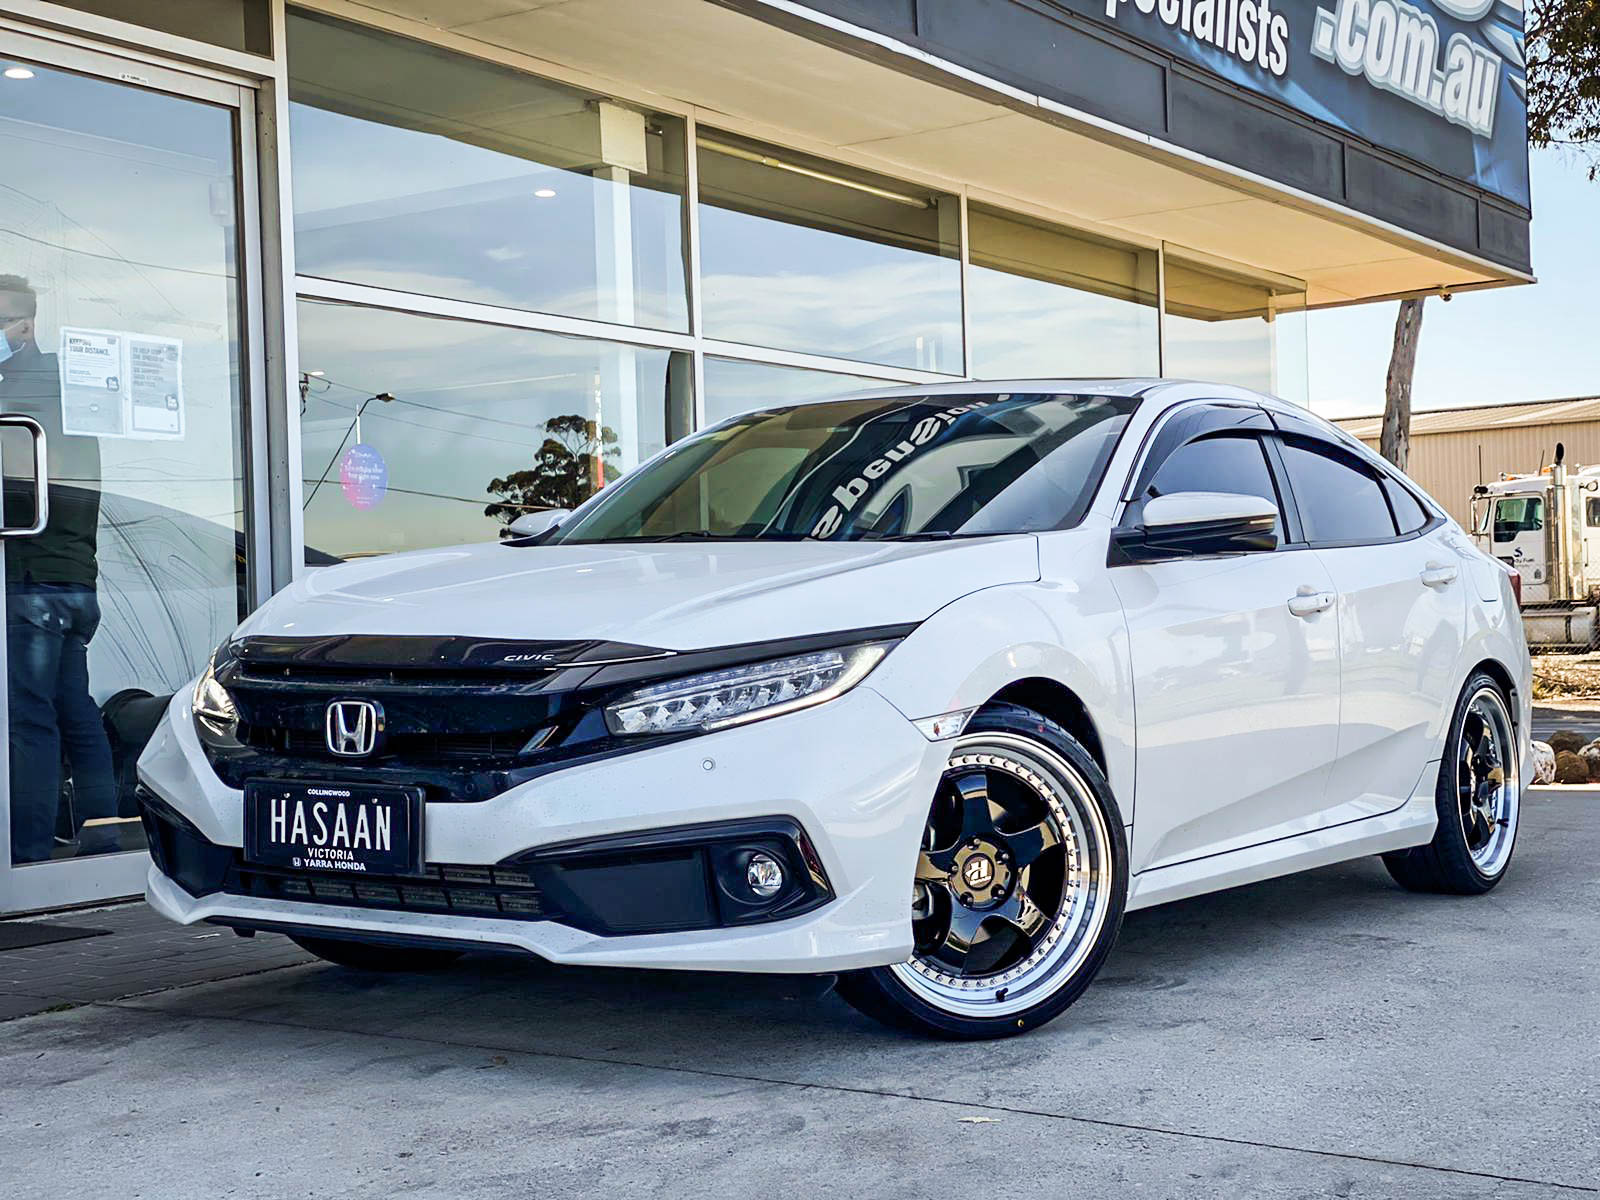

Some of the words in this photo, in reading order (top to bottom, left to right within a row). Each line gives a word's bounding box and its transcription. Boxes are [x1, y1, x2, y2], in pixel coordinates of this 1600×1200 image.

[1105, 0, 1289, 76] alists
[307, 788, 351, 797] COLLINGWOOD
[271, 799, 391, 851] HASAAN
[307, 847, 354, 861] VICTORIA
[303, 858, 333, 869] YARRA
[334, 860, 367, 871] HONDA
